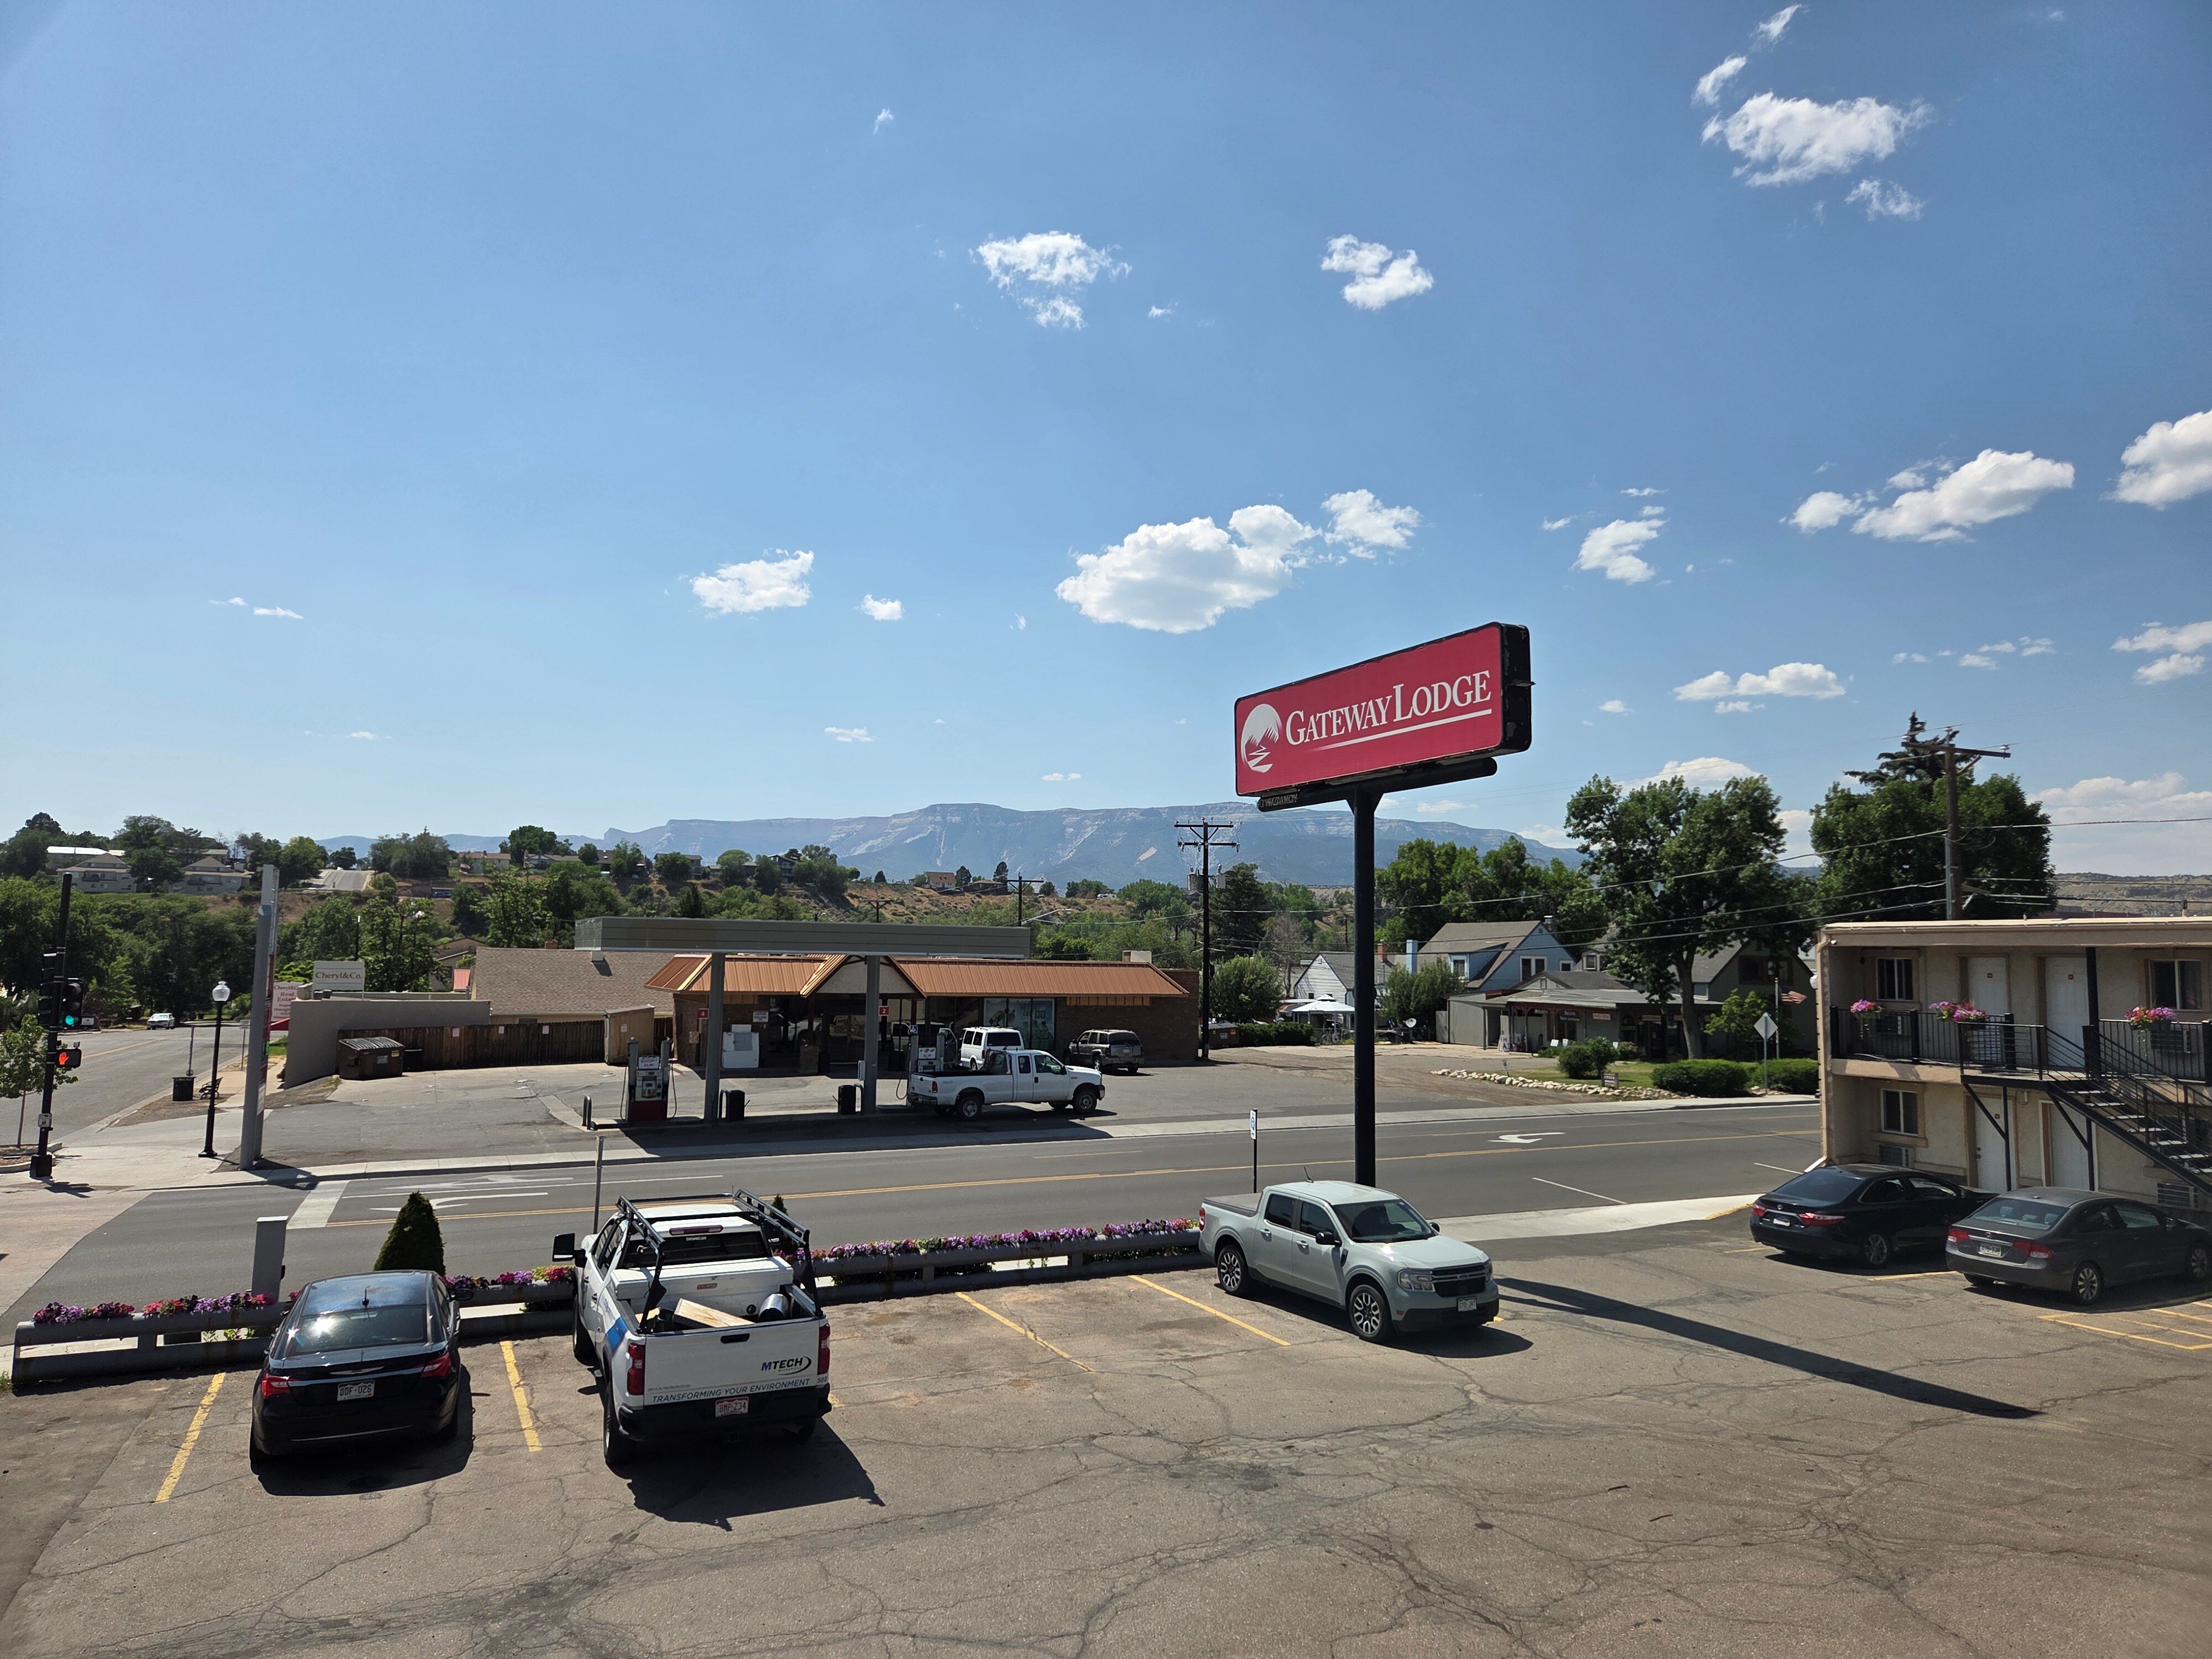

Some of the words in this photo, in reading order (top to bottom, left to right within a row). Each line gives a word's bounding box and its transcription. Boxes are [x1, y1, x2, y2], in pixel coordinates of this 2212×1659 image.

[1286, 695, 1392, 745] GATEWAY
[1393, 670, 1491, 723] LODGE
[315, 972, 362, 980] Cheryl&Co.
[761, 1357, 803, 1371] MTECH
[653, 1389, 722, 1403] TRANSFORMING
[724, 1386, 748, 1396] YOUR
[749, 1378, 811, 1392] ENVIRONMENT
